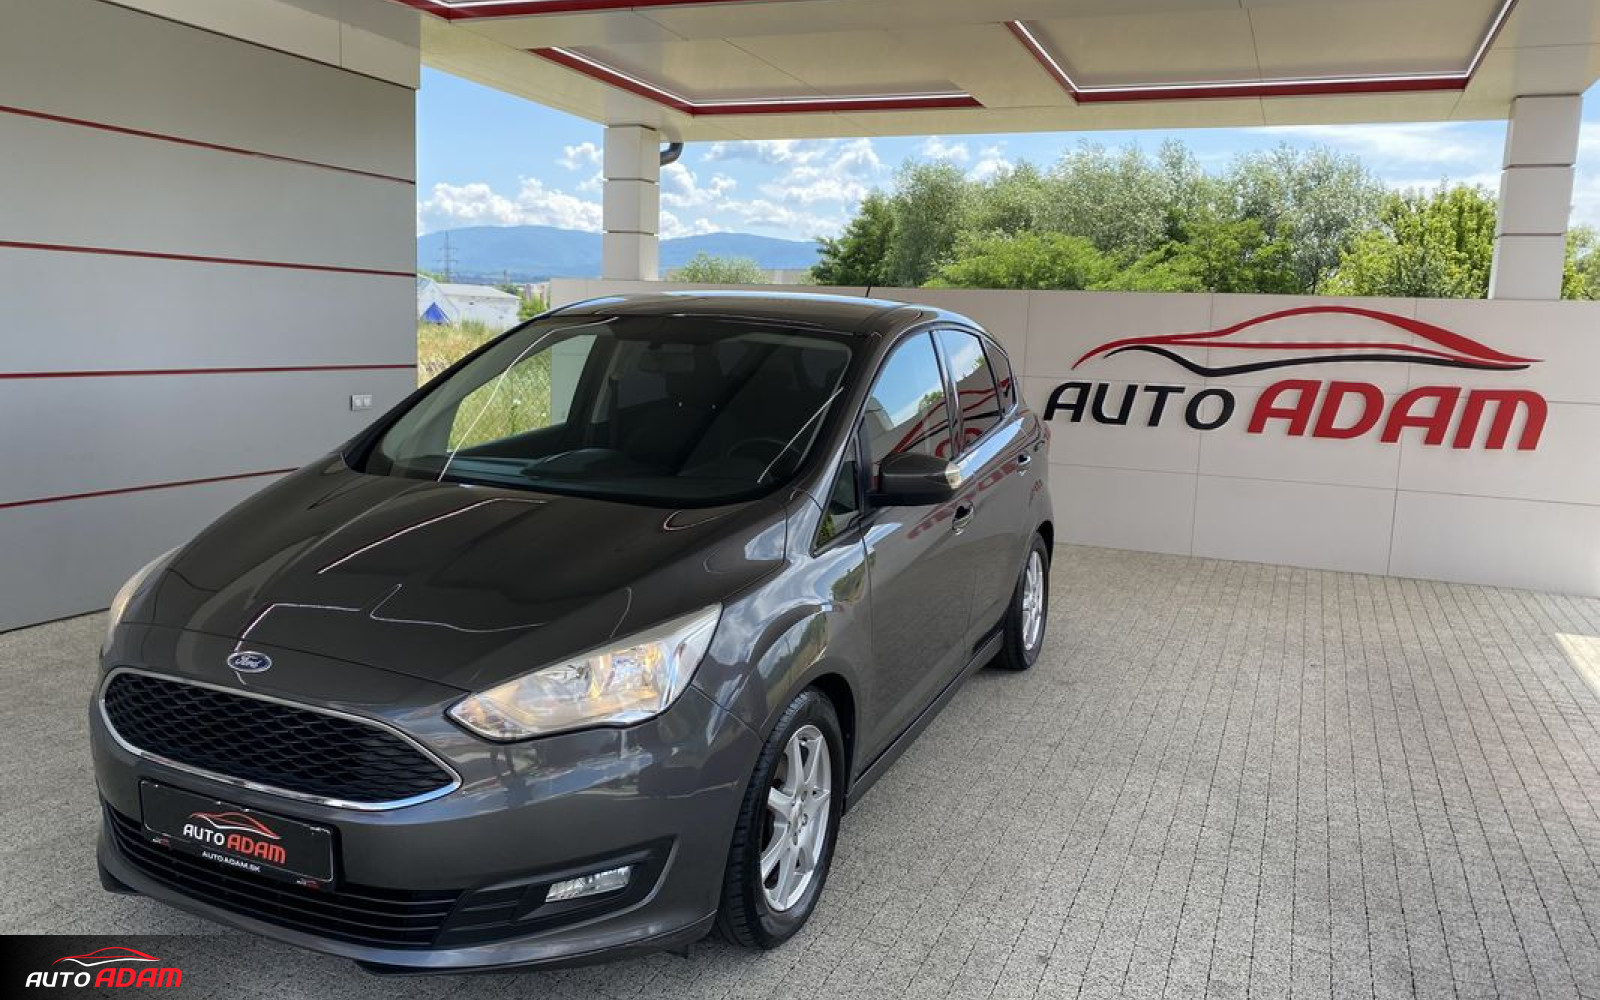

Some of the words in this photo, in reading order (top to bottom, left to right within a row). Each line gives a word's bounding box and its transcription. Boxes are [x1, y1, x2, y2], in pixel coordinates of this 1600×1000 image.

[1043, 382, 1235, 430] AUTO
[1247, 379, 1548, 451] ADAM
[234, 655, 263, 669] Ford
[183, 823, 226, 846] AUTO
[227, 833, 287, 864] ADAM
